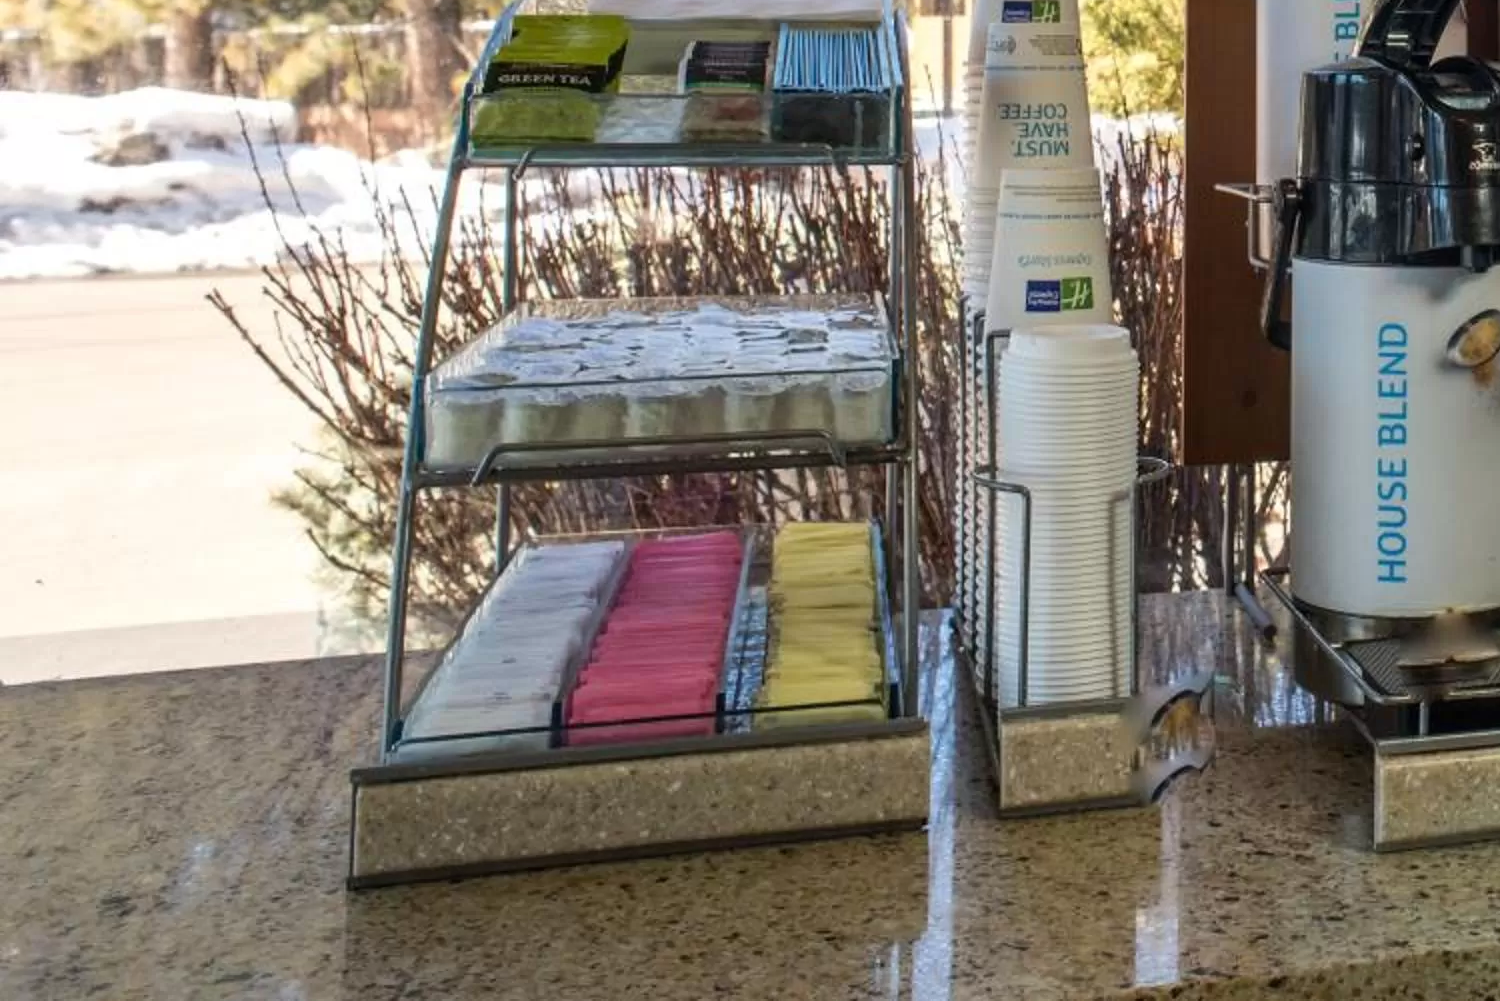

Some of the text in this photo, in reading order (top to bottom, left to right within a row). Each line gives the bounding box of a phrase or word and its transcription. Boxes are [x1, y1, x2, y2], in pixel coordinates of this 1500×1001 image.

[498, 74, 592, 87] GREEN TEA
[1010, 139, 1070, 157] MUST.
[1376, 321, 1409, 585] HOUSE BLEND
